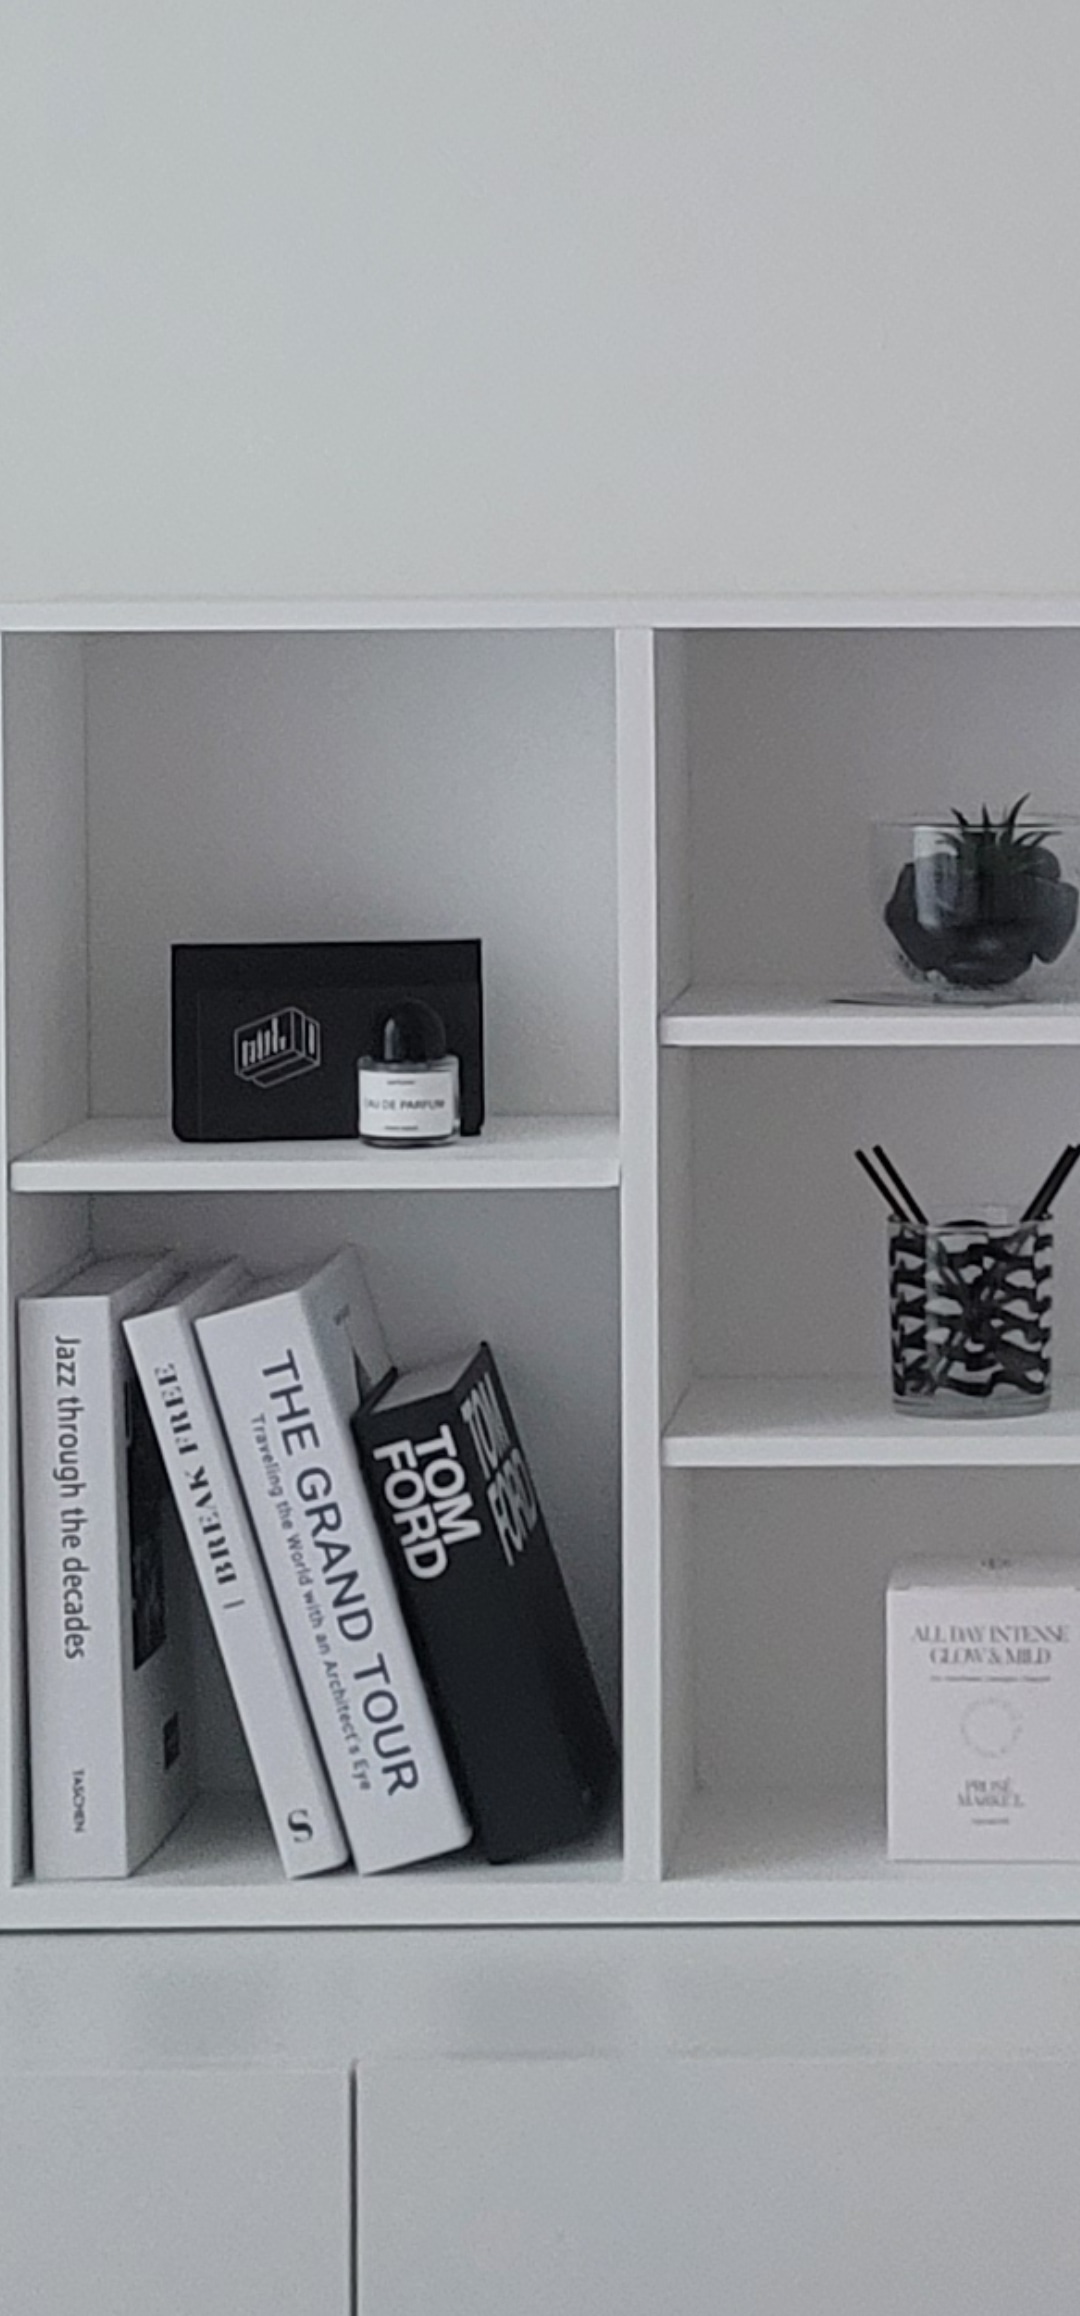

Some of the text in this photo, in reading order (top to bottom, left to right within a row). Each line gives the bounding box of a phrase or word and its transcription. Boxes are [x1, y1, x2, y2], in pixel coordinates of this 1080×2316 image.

[382, 1099, 396, 1110] DE
[399, 1099, 445, 1111] PARFUM
[53, 1334, 92, 1659] Jazz through the decades
[154, 1363, 237, 1585] BREAK FREE
[372, 1438, 448, 1580] FORD
[415, 1423, 482, 1545] TOM
[251, 1411, 284, 1498] Traveling
[276, 1500, 294, 1531] the
[286, 1533, 314, 1587] World
[302, 1589, 325, 1629] with
[315, 1633, 331, 1655] an
[351, 1757, 372, 1791] Eye
[262, 1348, 419, 1796] THE GRAND TOUR
[911, 1624, 1071, 1643] ALL DAY INTENSE
[929, 1647, 985, 1665] GLOW
[1004, 1647, 1052, 1665] MILD
[73, 1769, 86, 1834] TASCHEN
